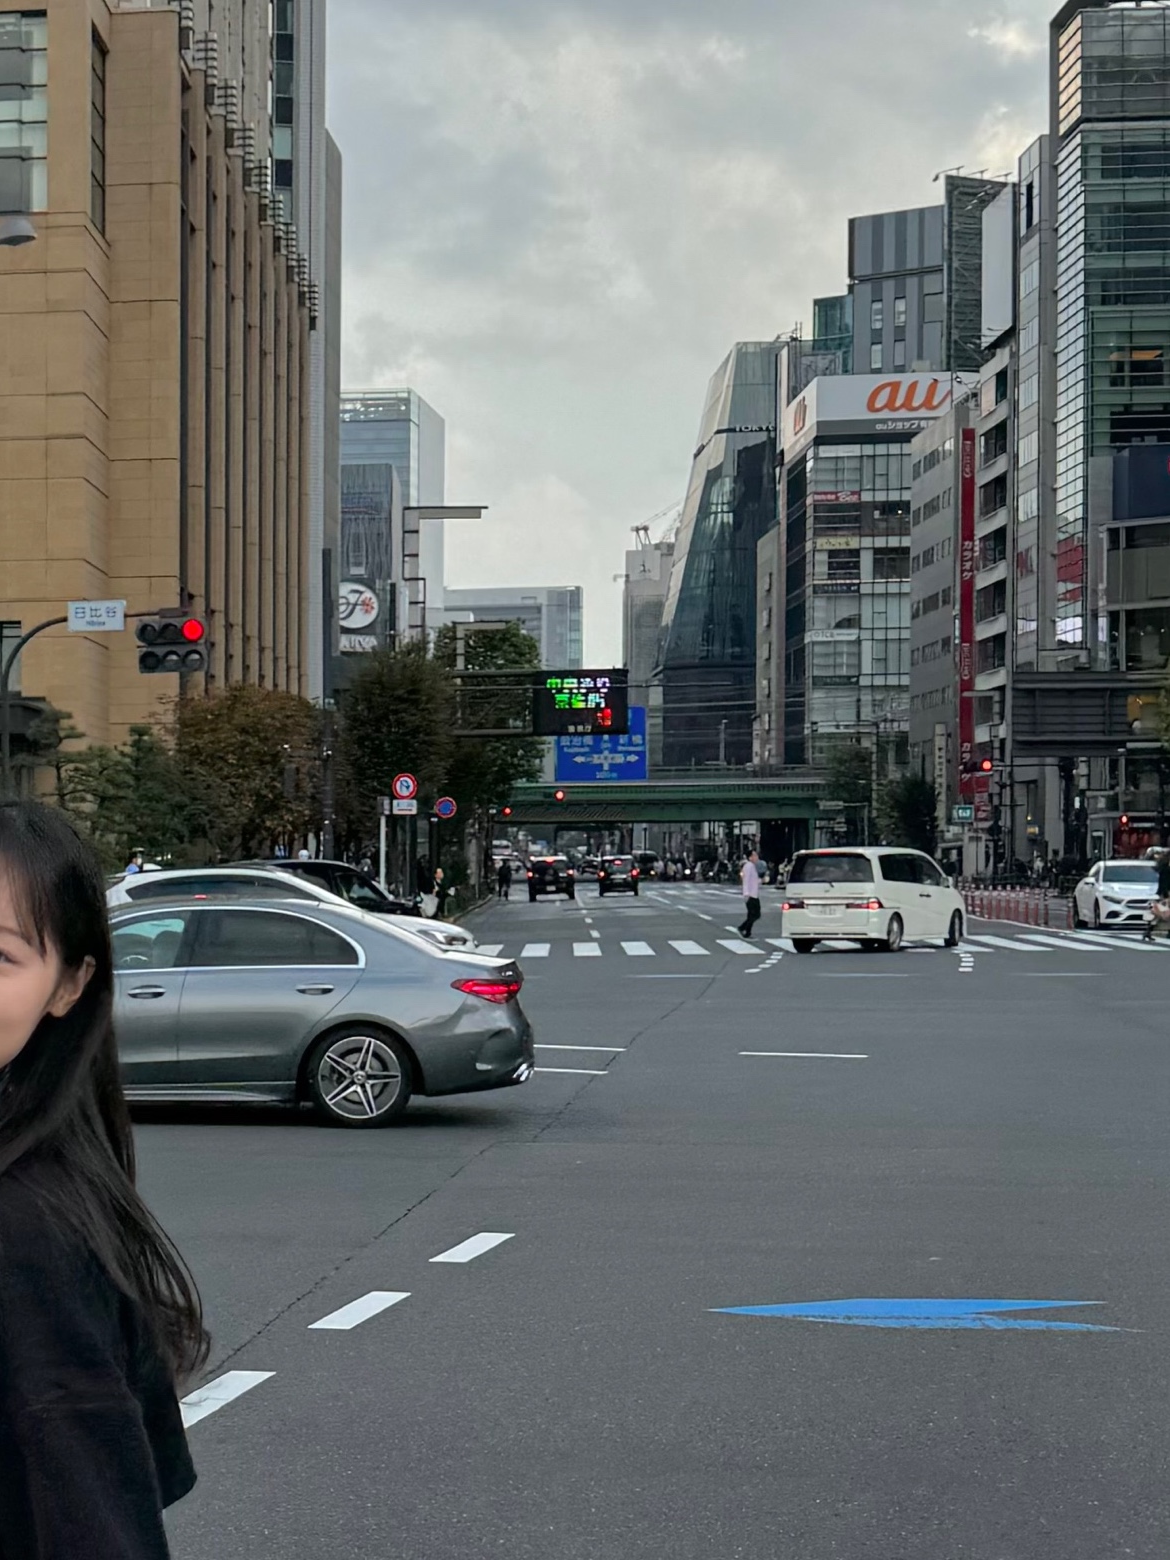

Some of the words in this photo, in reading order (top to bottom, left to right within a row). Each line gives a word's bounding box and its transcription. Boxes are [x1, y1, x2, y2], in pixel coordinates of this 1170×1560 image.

[866, 380, 952, 413] au
[875, 420, 934, 430] auショップ有
[962, 541, 973, 581] カラオケ
[75, 606, 117, 619] 日比谷
[961, 743, 972, 782] カラケ
